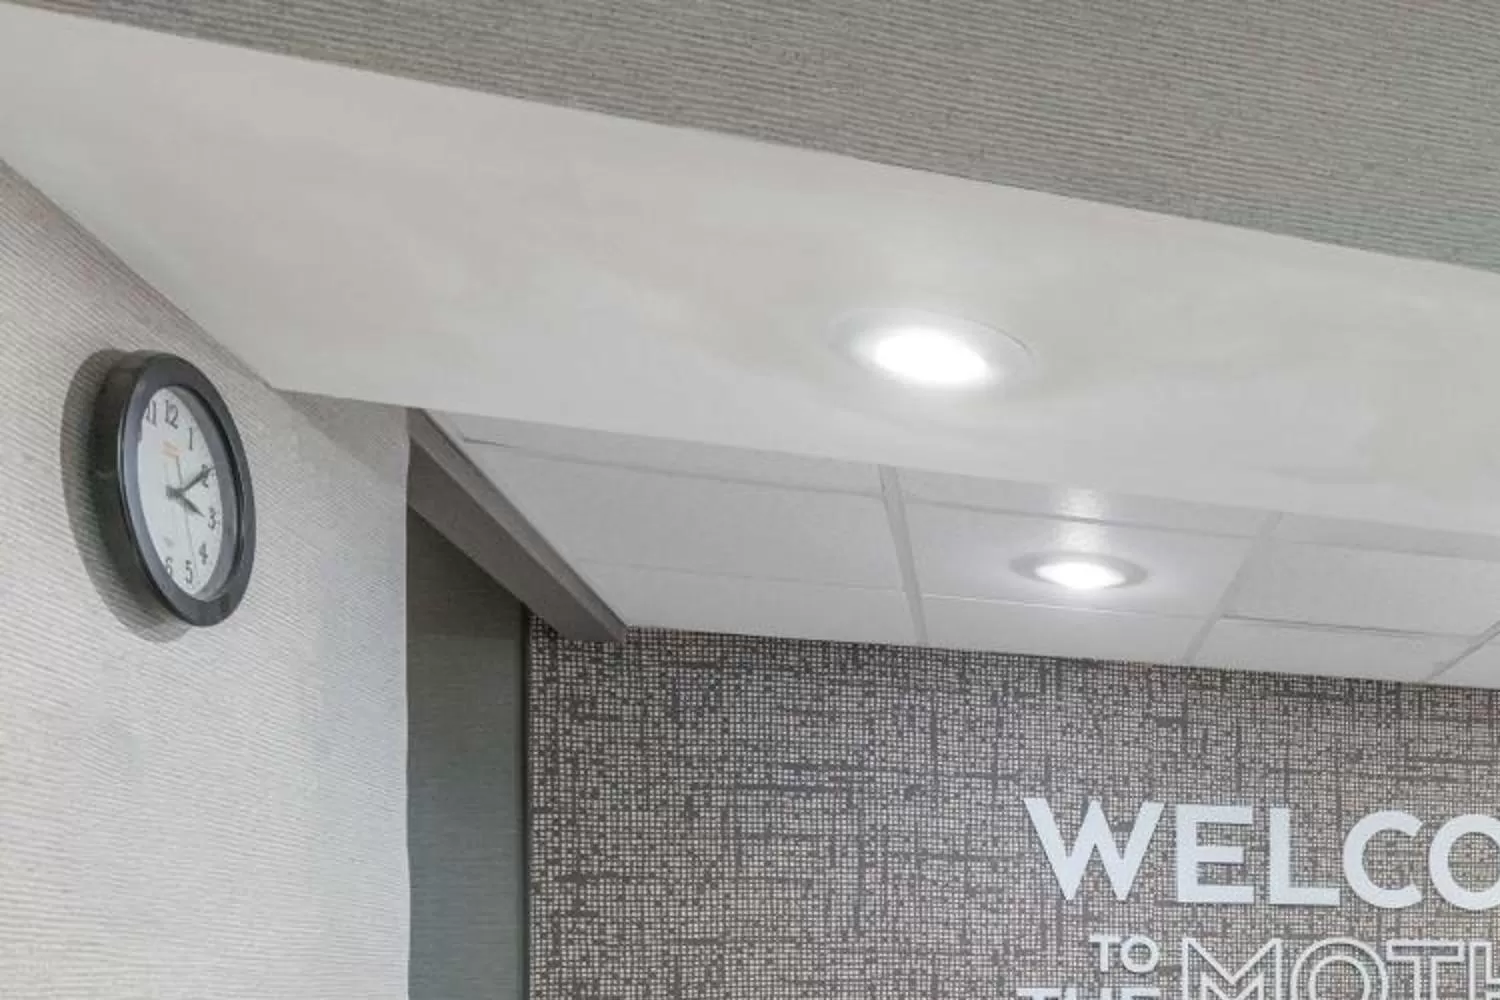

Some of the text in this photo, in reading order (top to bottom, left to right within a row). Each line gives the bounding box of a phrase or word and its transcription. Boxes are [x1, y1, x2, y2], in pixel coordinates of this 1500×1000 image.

[164, 399, 179, 430] 12
[207, 506, 217, 530] 3
[198, 542, 208, 566] 4
[185, 559, 193, 584] 5
[1089, 934, 1161, 973] TO
